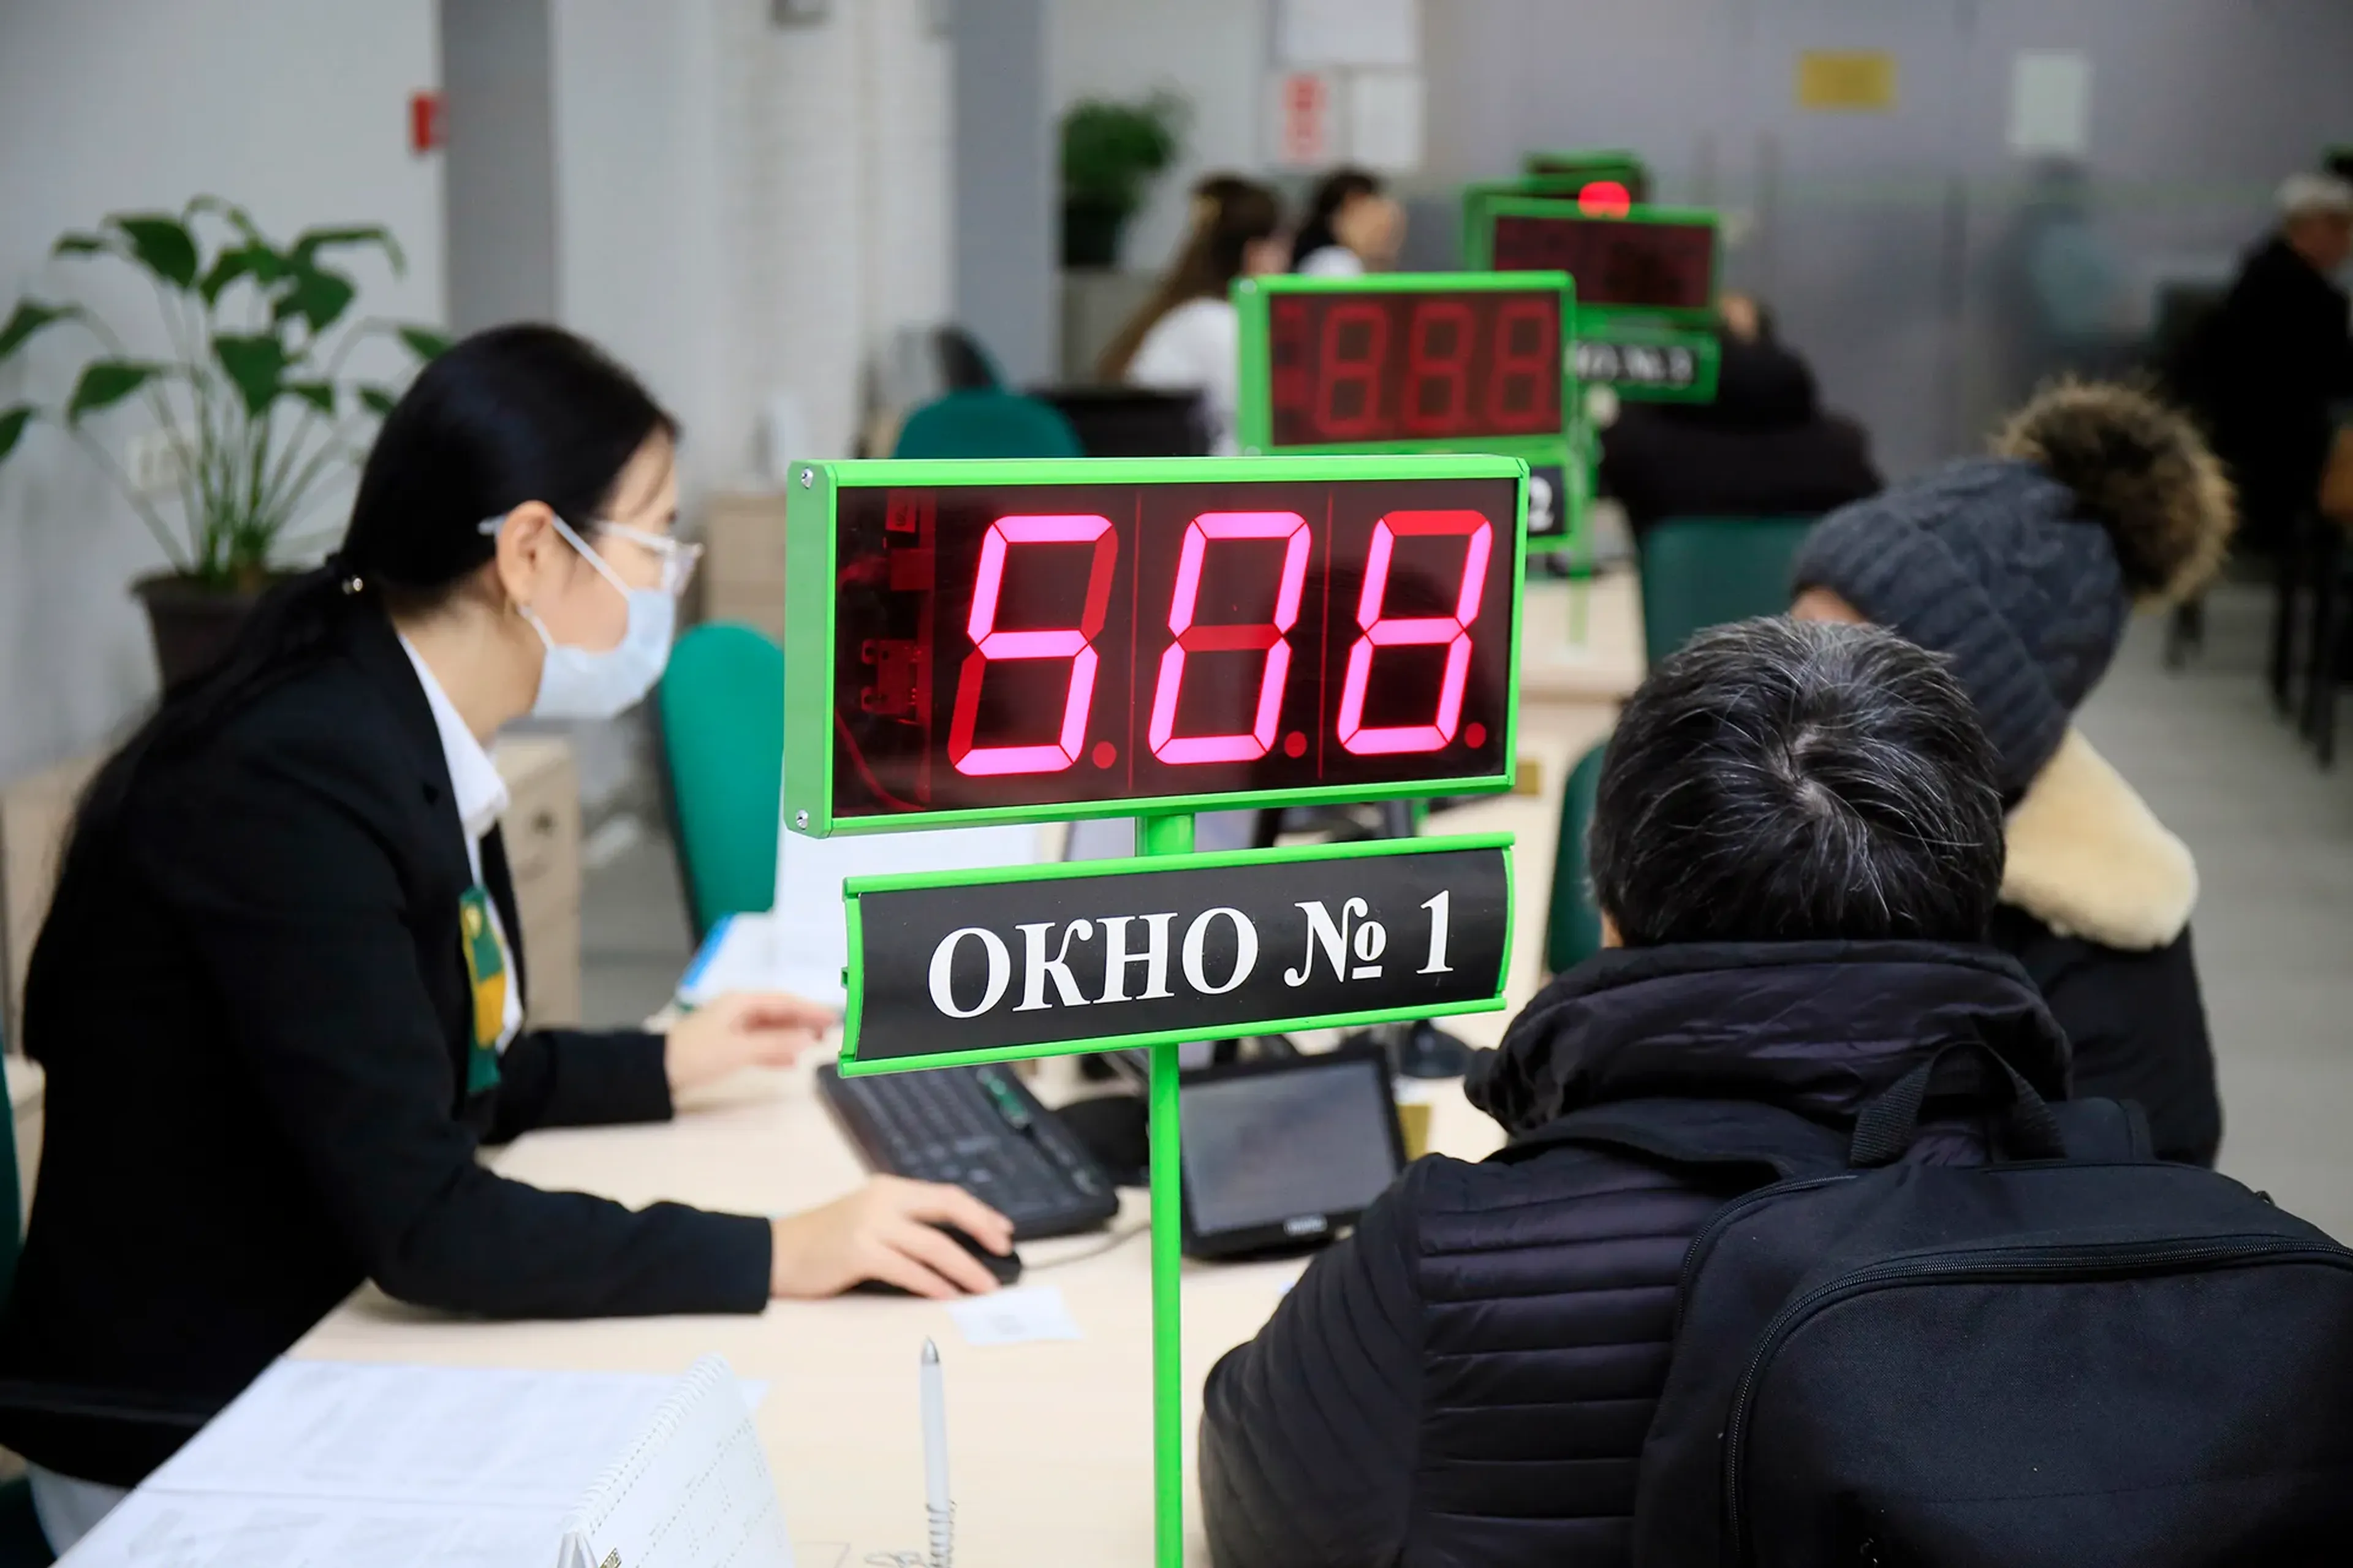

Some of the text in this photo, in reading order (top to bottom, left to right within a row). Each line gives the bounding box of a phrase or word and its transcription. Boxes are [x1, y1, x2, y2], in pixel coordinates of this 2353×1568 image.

[928, 889, 1454, 1019] ОКНО № 1
